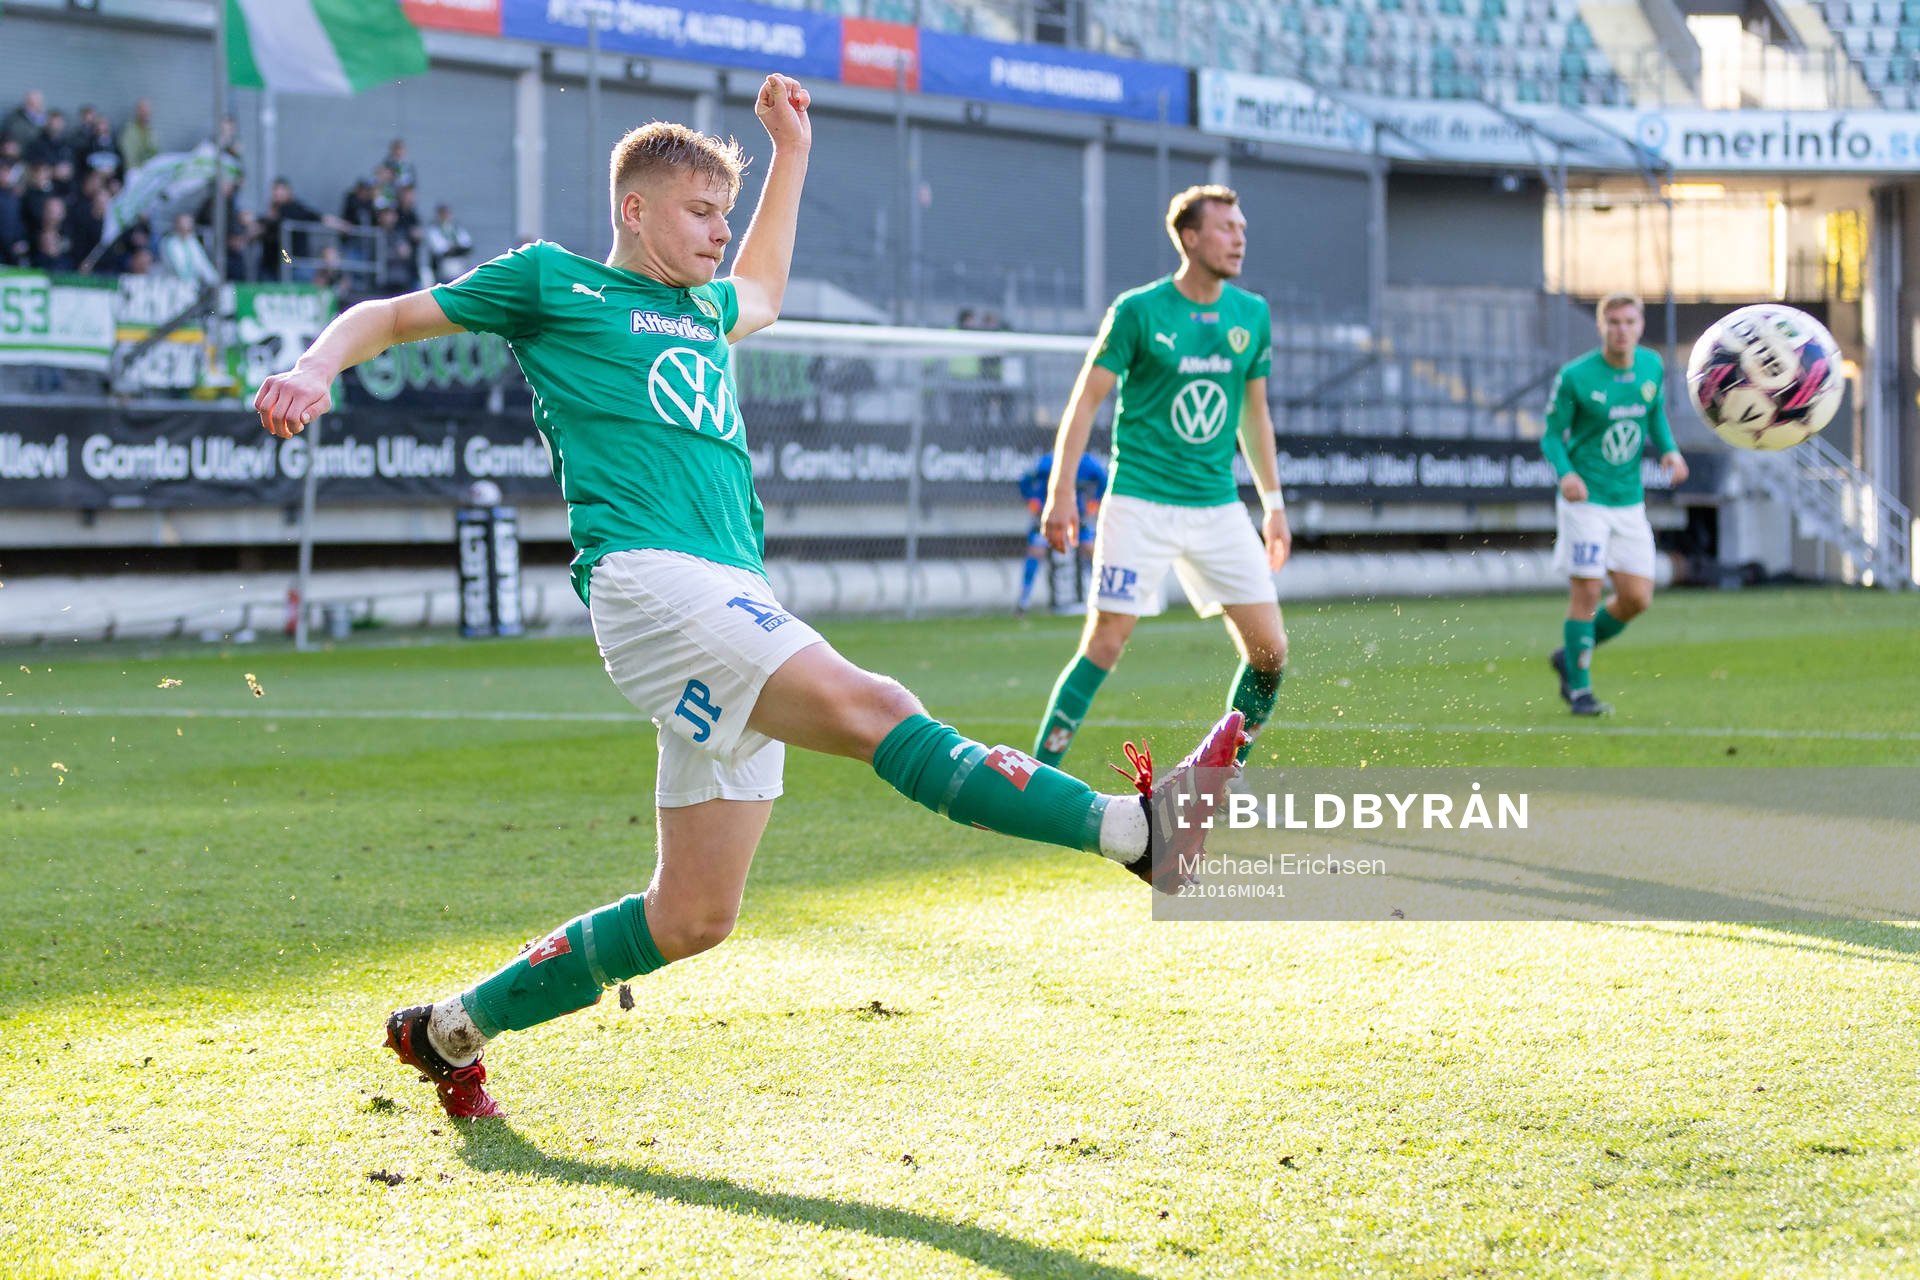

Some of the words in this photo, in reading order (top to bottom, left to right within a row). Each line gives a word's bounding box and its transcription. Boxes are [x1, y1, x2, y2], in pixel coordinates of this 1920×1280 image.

[631, 310, 718, 341] Atteviks
[1178, 354, 1233, 374] Atteviks
[0, 432, 69, 479] llevi
[82, 433, 189, 480] Gamla
[190, 435, 276, 480] Ullevi
[279, 435, 375, 479] Gamla
[376, 435, 455, 479] Ullevi
[1099, 565, 1137, 593] NP
[726, 592, 781, 625] N
[674, 678, 722, 743] JP
